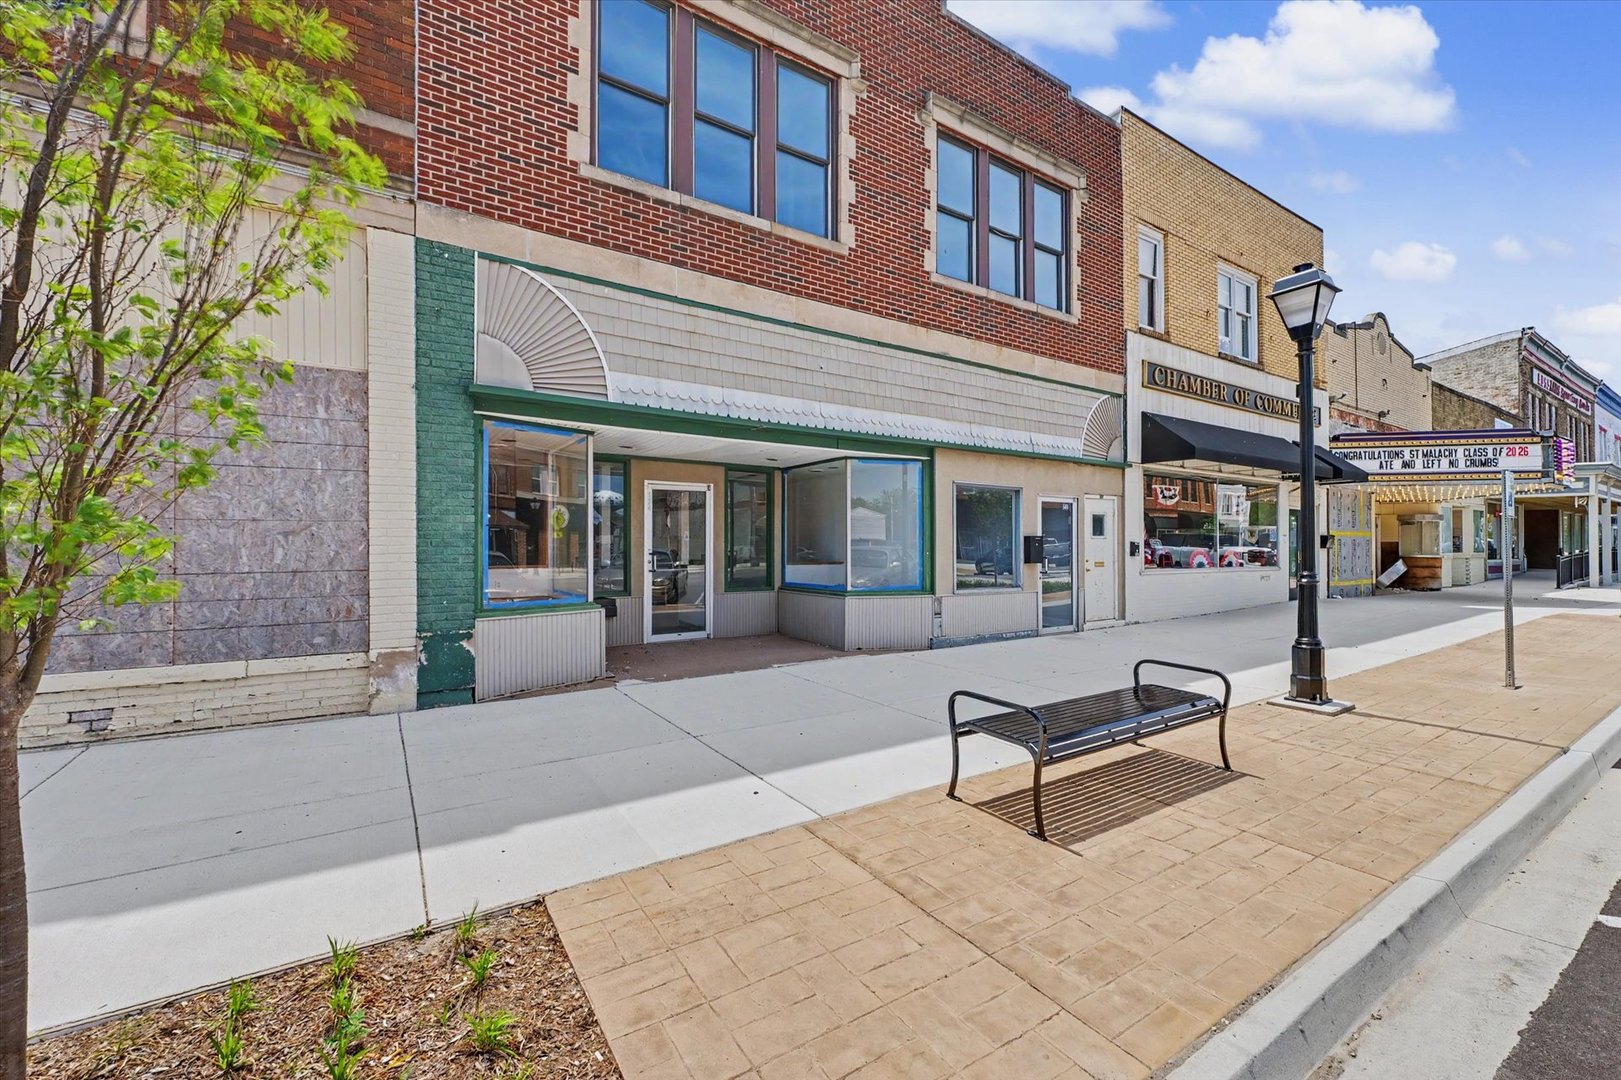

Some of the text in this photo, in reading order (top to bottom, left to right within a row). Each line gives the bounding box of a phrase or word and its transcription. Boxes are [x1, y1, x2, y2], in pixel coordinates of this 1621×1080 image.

[1153, 366, 1300, 420] CHAMBER OF COMME
[1409, 449, 1420, 459] ST
[1421, 448, 1458, 459] MALACHY
[1463, 447, 1489, 458] CLASS
[1492, 447, 1505, 458] OF
[1505, 446, 1529, 457] 2026
[1379, 460, 1394, 470] ATE
[1401, 459, 1417, 470] AND
[1422, 459, 1442, 470] LEFT
[1448, 458, 1460, 469] NO
